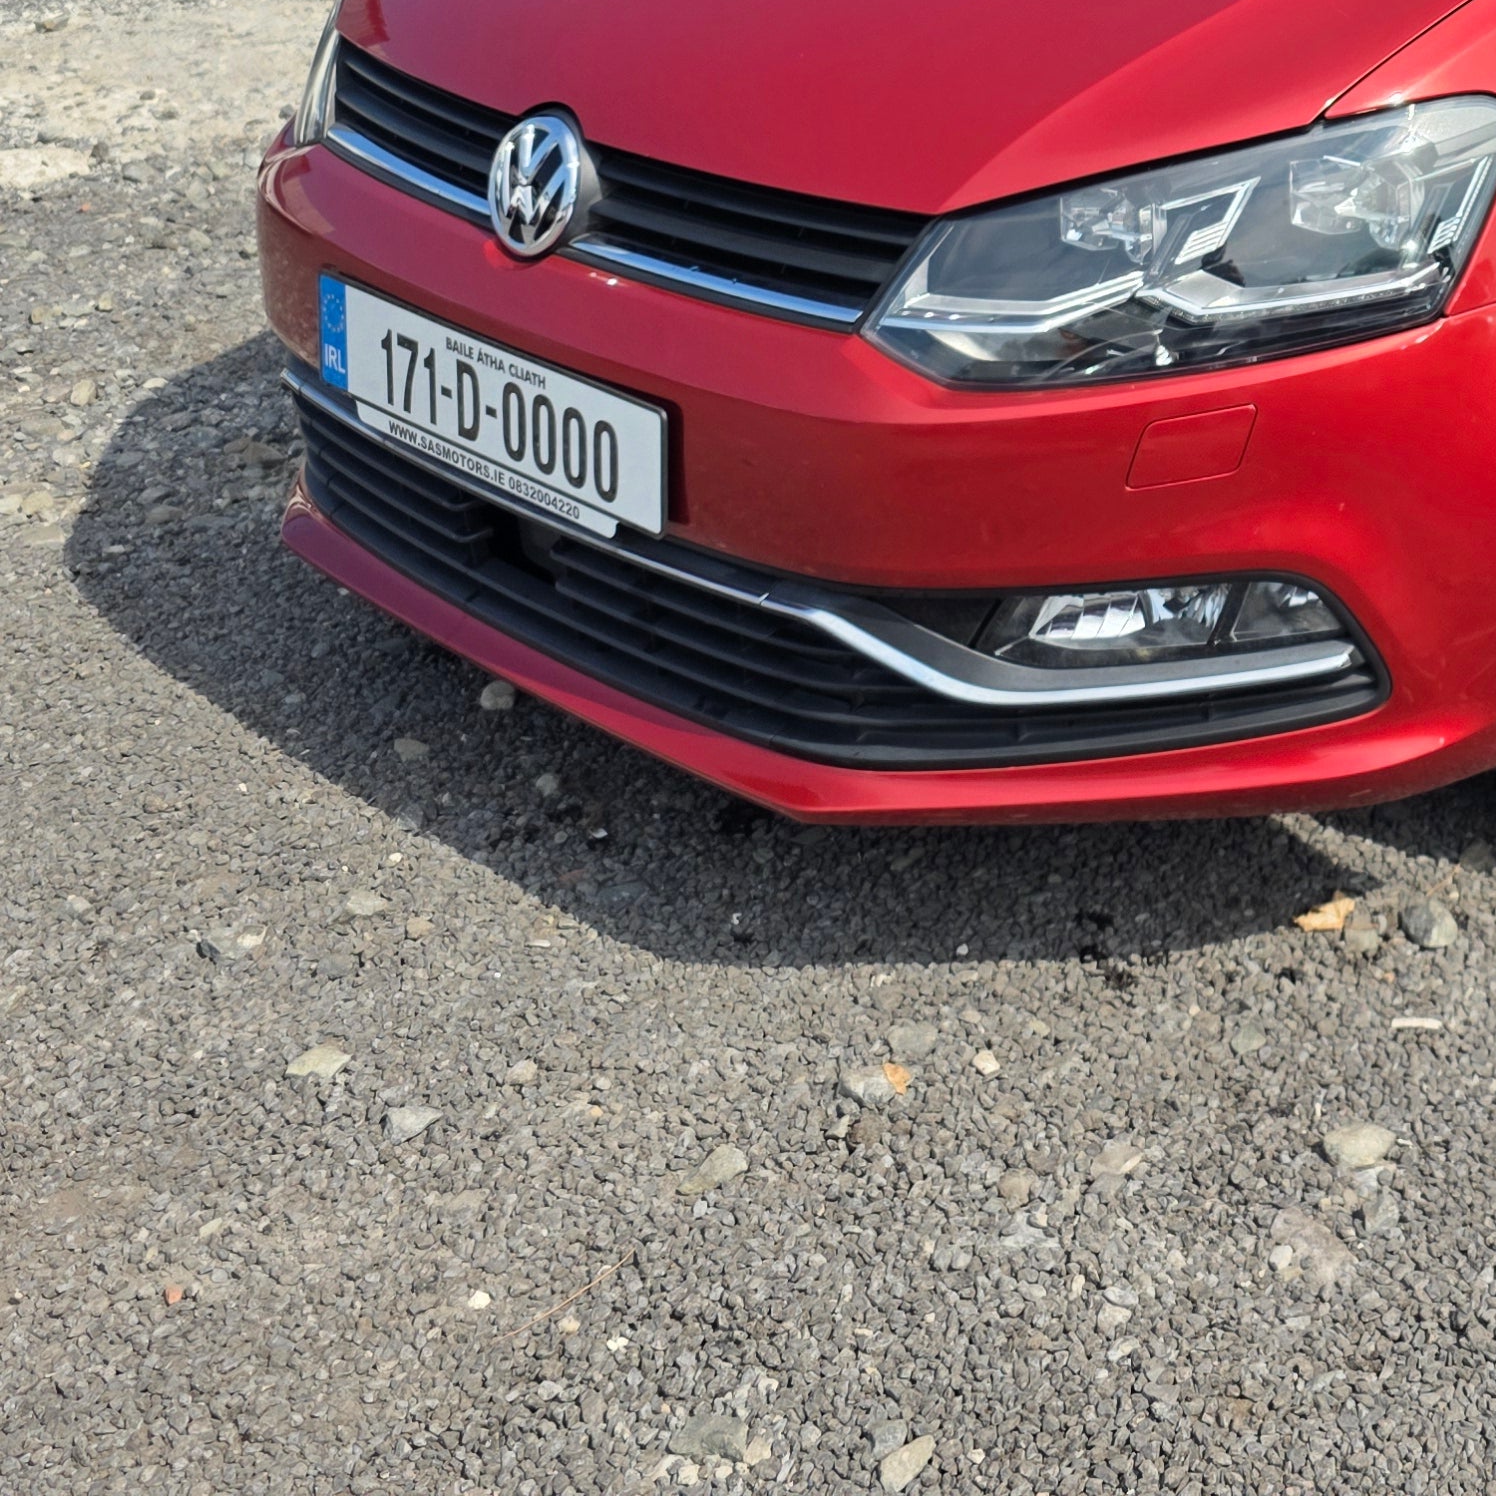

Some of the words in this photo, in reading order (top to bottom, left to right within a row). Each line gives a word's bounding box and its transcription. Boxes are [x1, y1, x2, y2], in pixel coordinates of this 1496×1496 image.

[324, 343, 346, 374] IRL
[445, 336, 475, 360] BAILE
[477, 348, 506, 374] ÁTHA
[509, 363, 546, 390] CLIATH
[381, 329, 619, 503] 171-D-0000
[388, 419, 505, 486] WWW.SASMOTORS.IE
[508, 476, 580, 520] 0832004220
